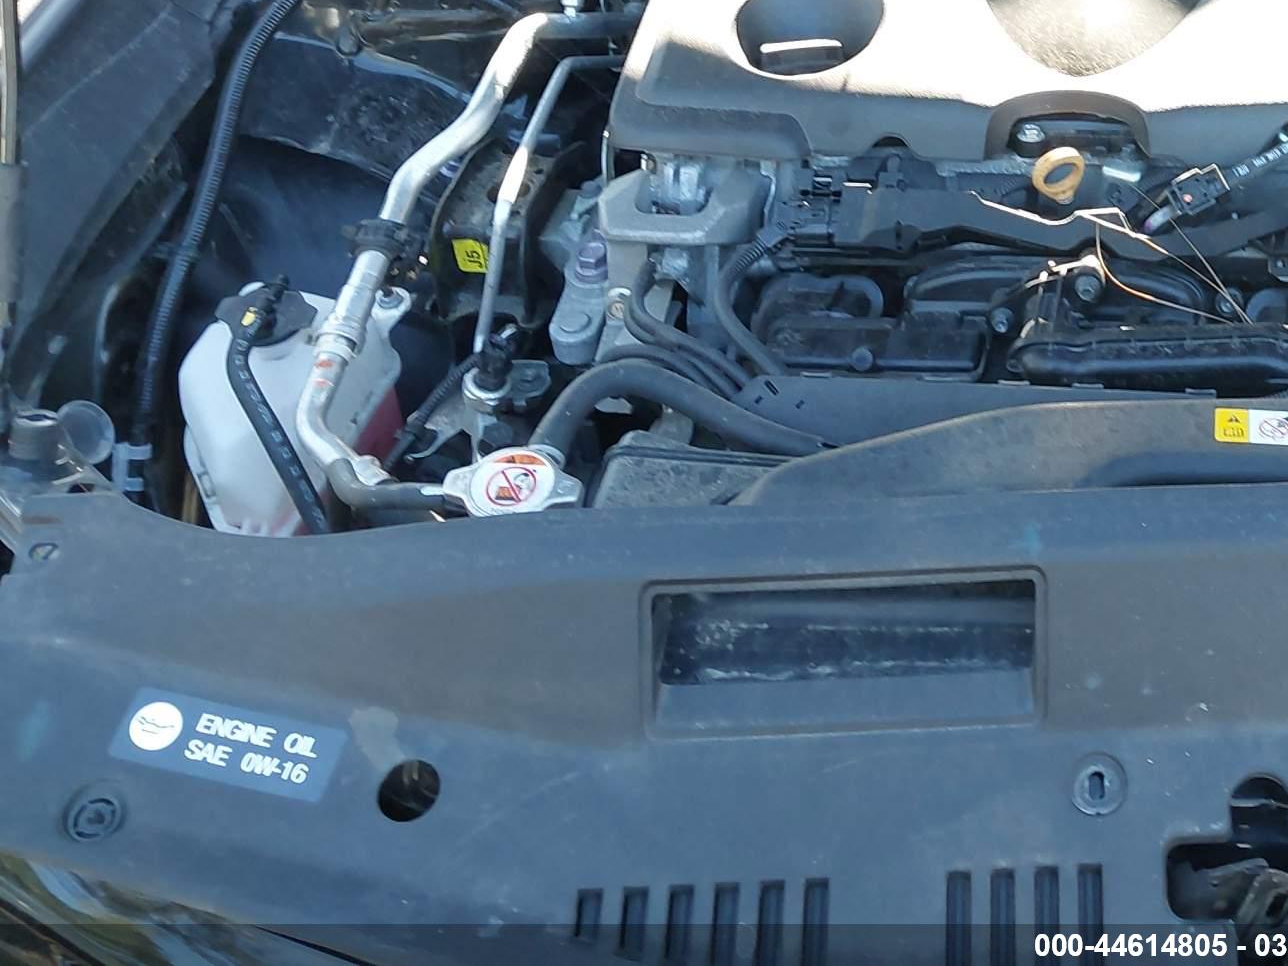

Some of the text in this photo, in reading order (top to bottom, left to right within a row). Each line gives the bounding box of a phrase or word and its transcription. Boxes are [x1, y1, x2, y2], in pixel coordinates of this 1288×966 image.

[196, 713, 318, 758] ENGINE OIL
[184, 739, 309, 784] SAE 0W-16
